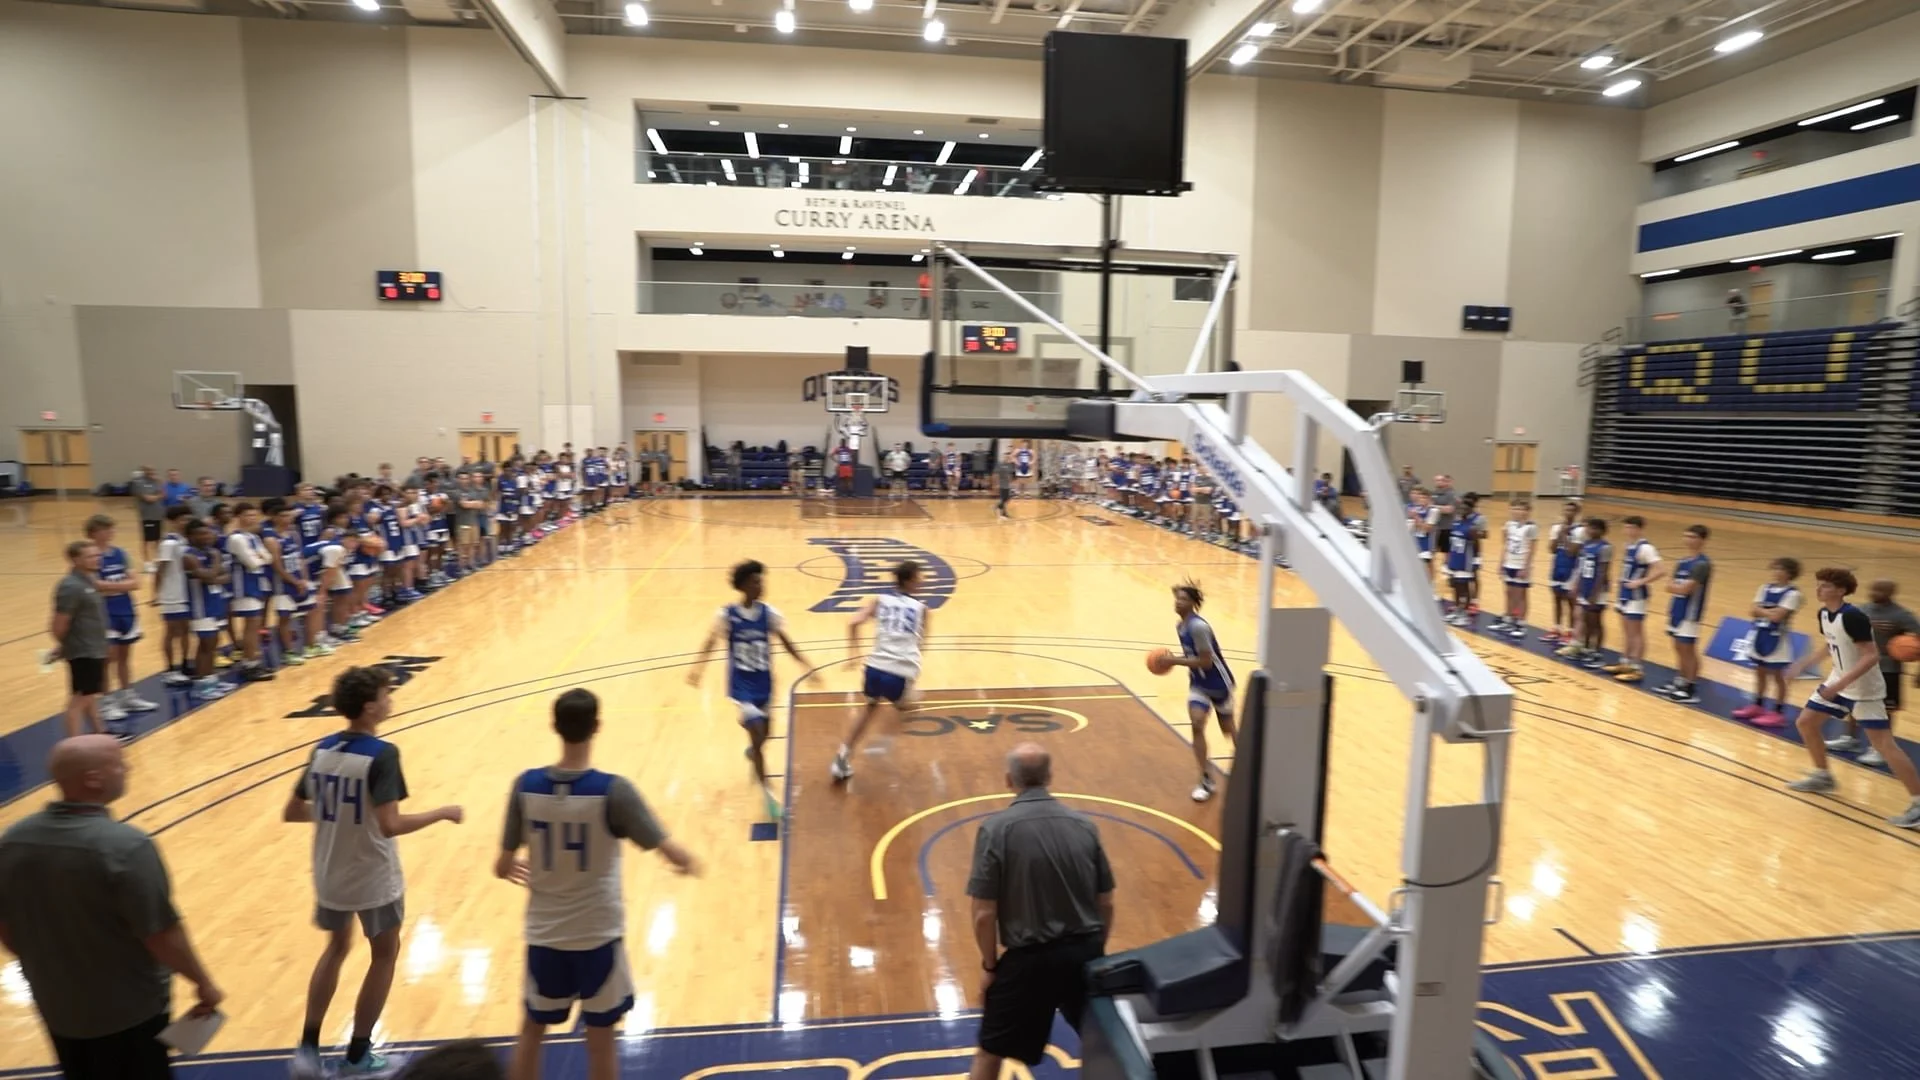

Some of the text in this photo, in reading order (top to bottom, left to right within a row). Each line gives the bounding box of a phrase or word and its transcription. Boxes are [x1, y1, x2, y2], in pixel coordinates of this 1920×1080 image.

[805, 197, 906, 210] BETH & RAVENEL
[775, 209, 936, 232] CURRY ARENA
[531, 820, 590, 872] 74
